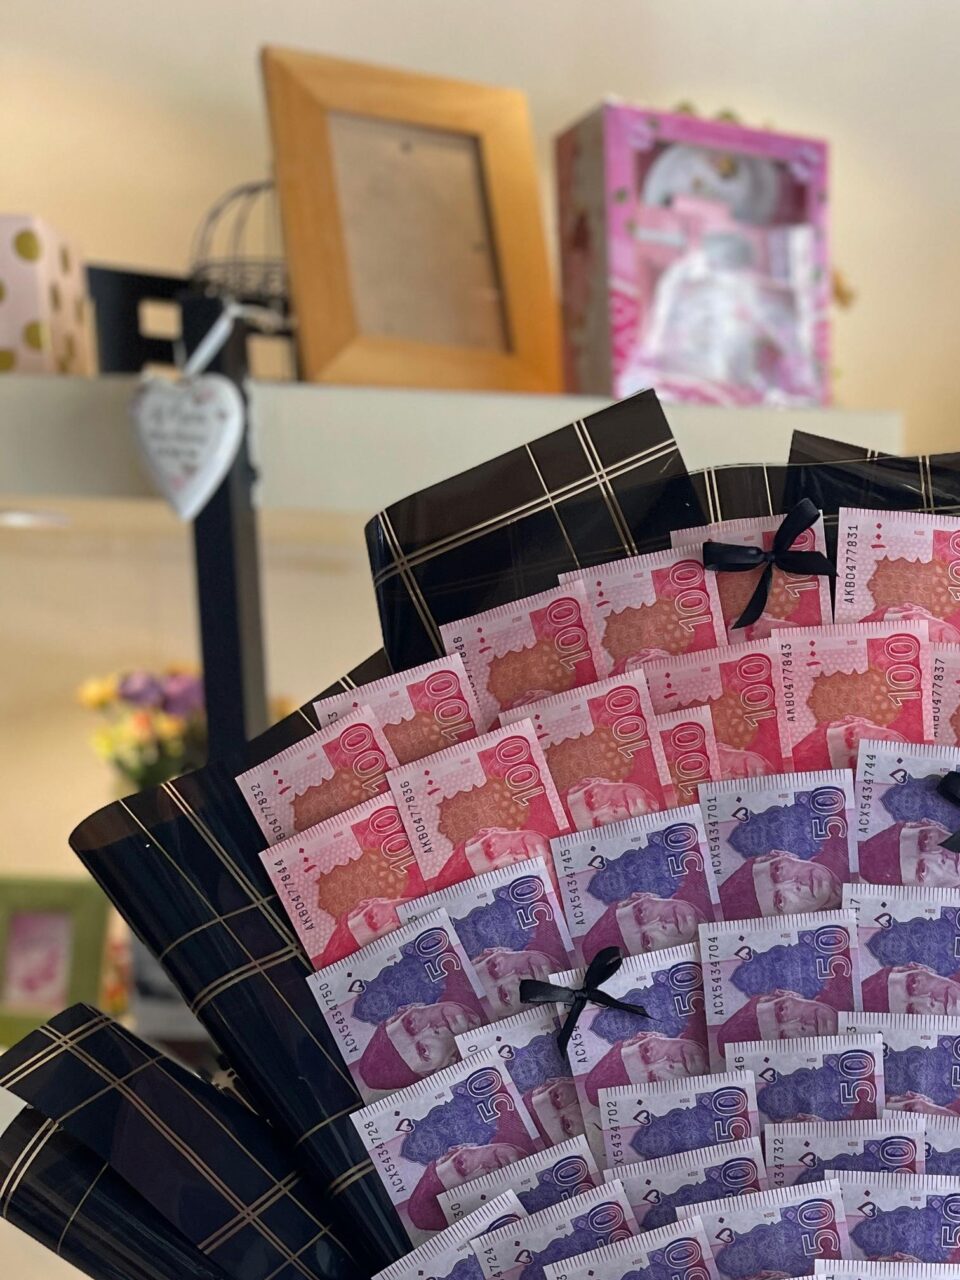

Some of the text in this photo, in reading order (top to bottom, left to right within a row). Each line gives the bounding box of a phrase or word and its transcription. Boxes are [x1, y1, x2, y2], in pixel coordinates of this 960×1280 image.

[669, 559, 711, 632] 100
[547, 597, 592, 671] 100
[737, 653, 776, 728] 100
[884, 633, 922, 706] 100
[424, 670, 475, 741] 100
[604, 685, 649, 759] 100
[340, 723, 387, 794] 100
[495, 735, 544, 807] 100
[369, 806, 416, 875] 100
[810, 785, 848, 840] 50
[663, 822, 704, 877] 50
[508, 875, 553, 930] 50
[415, 927, 461, 983] 50
[814, 925, 852, 979] 50
[668, 961, 704, 1017] 50
[466, 1066, 515, 1123] 50
[839, 1049, 877, 1105] 50
[712, 1086, 751, 1142] 50
[797, 1199, 841, 1256] 50
